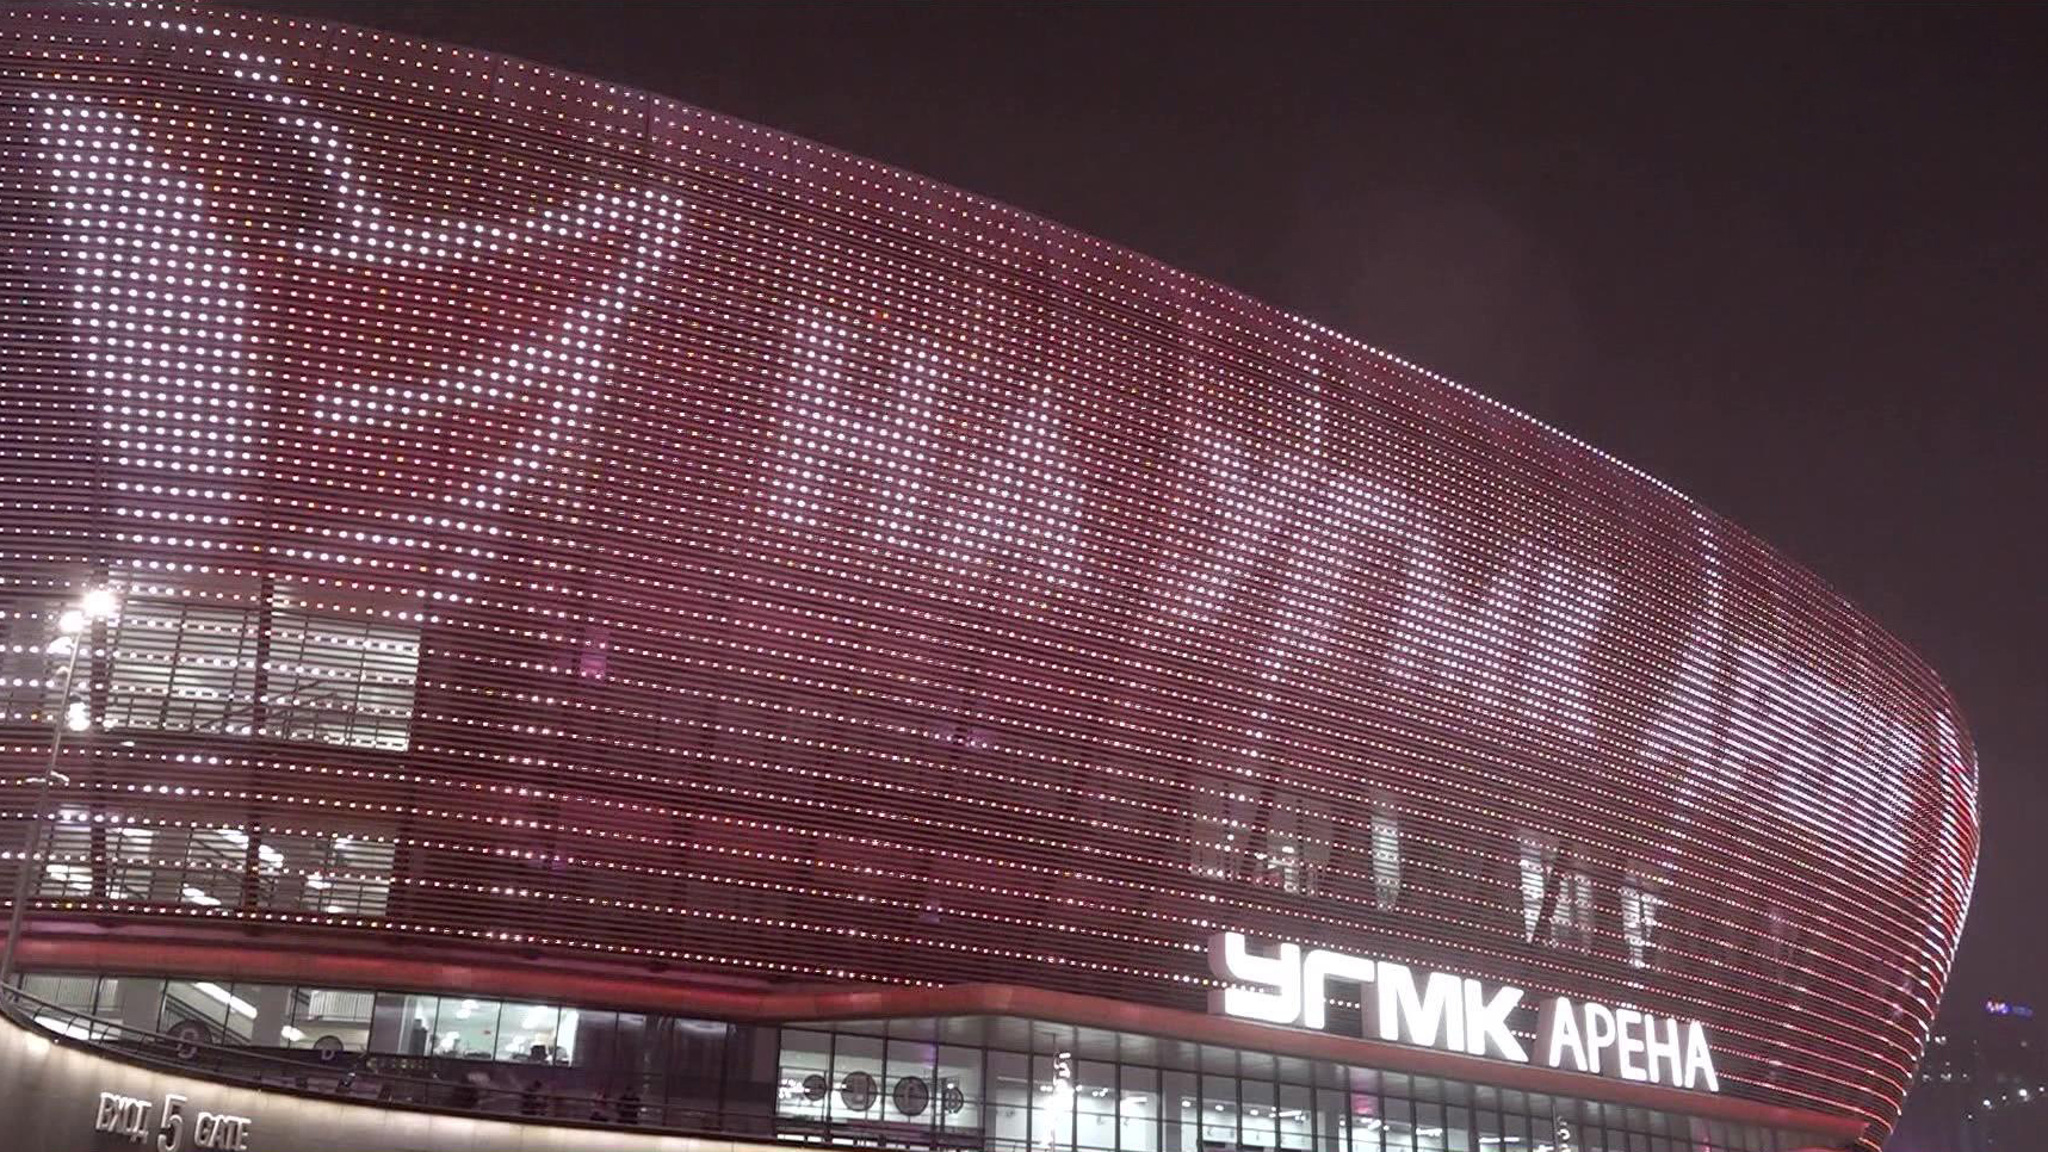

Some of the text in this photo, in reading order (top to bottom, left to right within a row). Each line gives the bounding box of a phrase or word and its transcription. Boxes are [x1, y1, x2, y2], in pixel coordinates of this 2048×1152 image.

[1222, 931, 1719, 1092] УГМК АРЕНА
[95, 1092, 251, 1152] ВХОД 5 GATE
